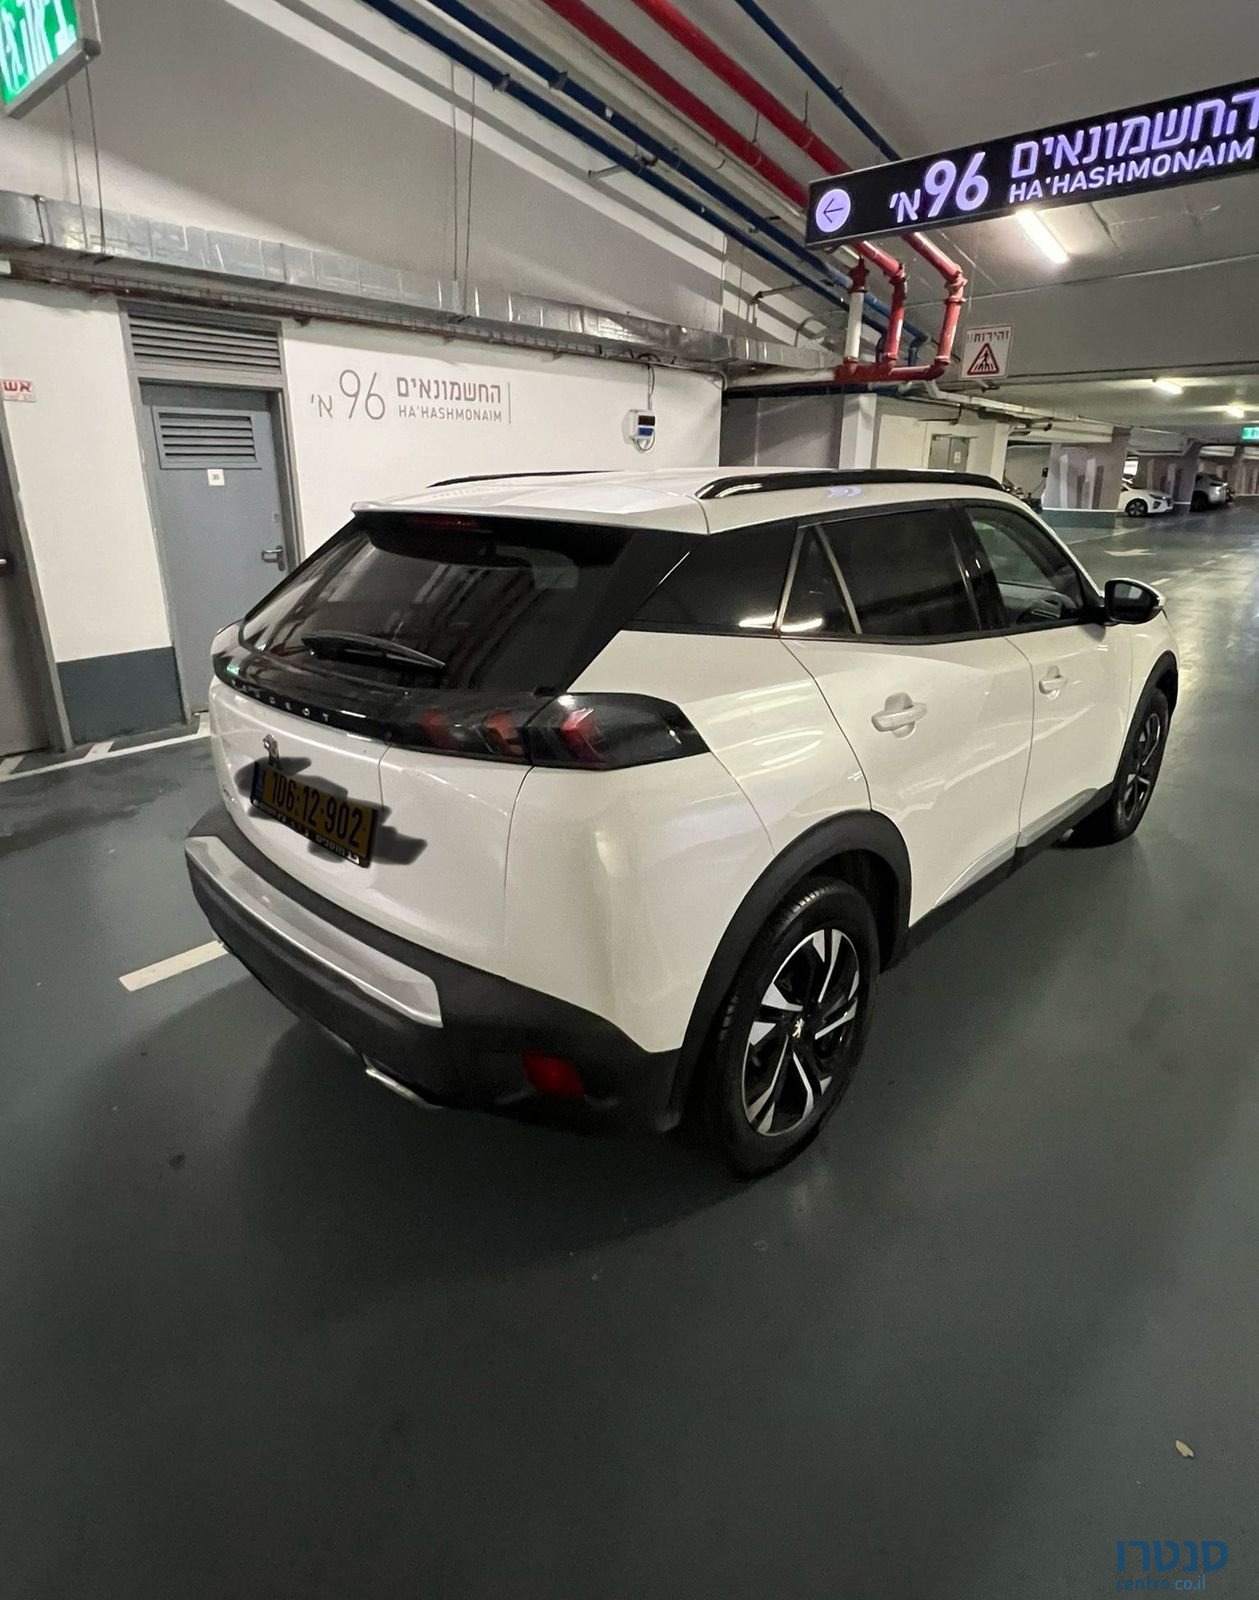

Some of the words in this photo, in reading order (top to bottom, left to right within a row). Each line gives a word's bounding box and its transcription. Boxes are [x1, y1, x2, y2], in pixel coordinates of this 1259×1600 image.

[1010, 89, 1259, 179] החשמונאים
[922, 151, 989, 218] 96
[1008, 136, 1256, 204] HA'HASHMONAIM
[339, 369, 386, 421] 96
[396, 376, 502, 404] החשמונאים
[399, 404, 502, 423] HA'HASHMONAIM
